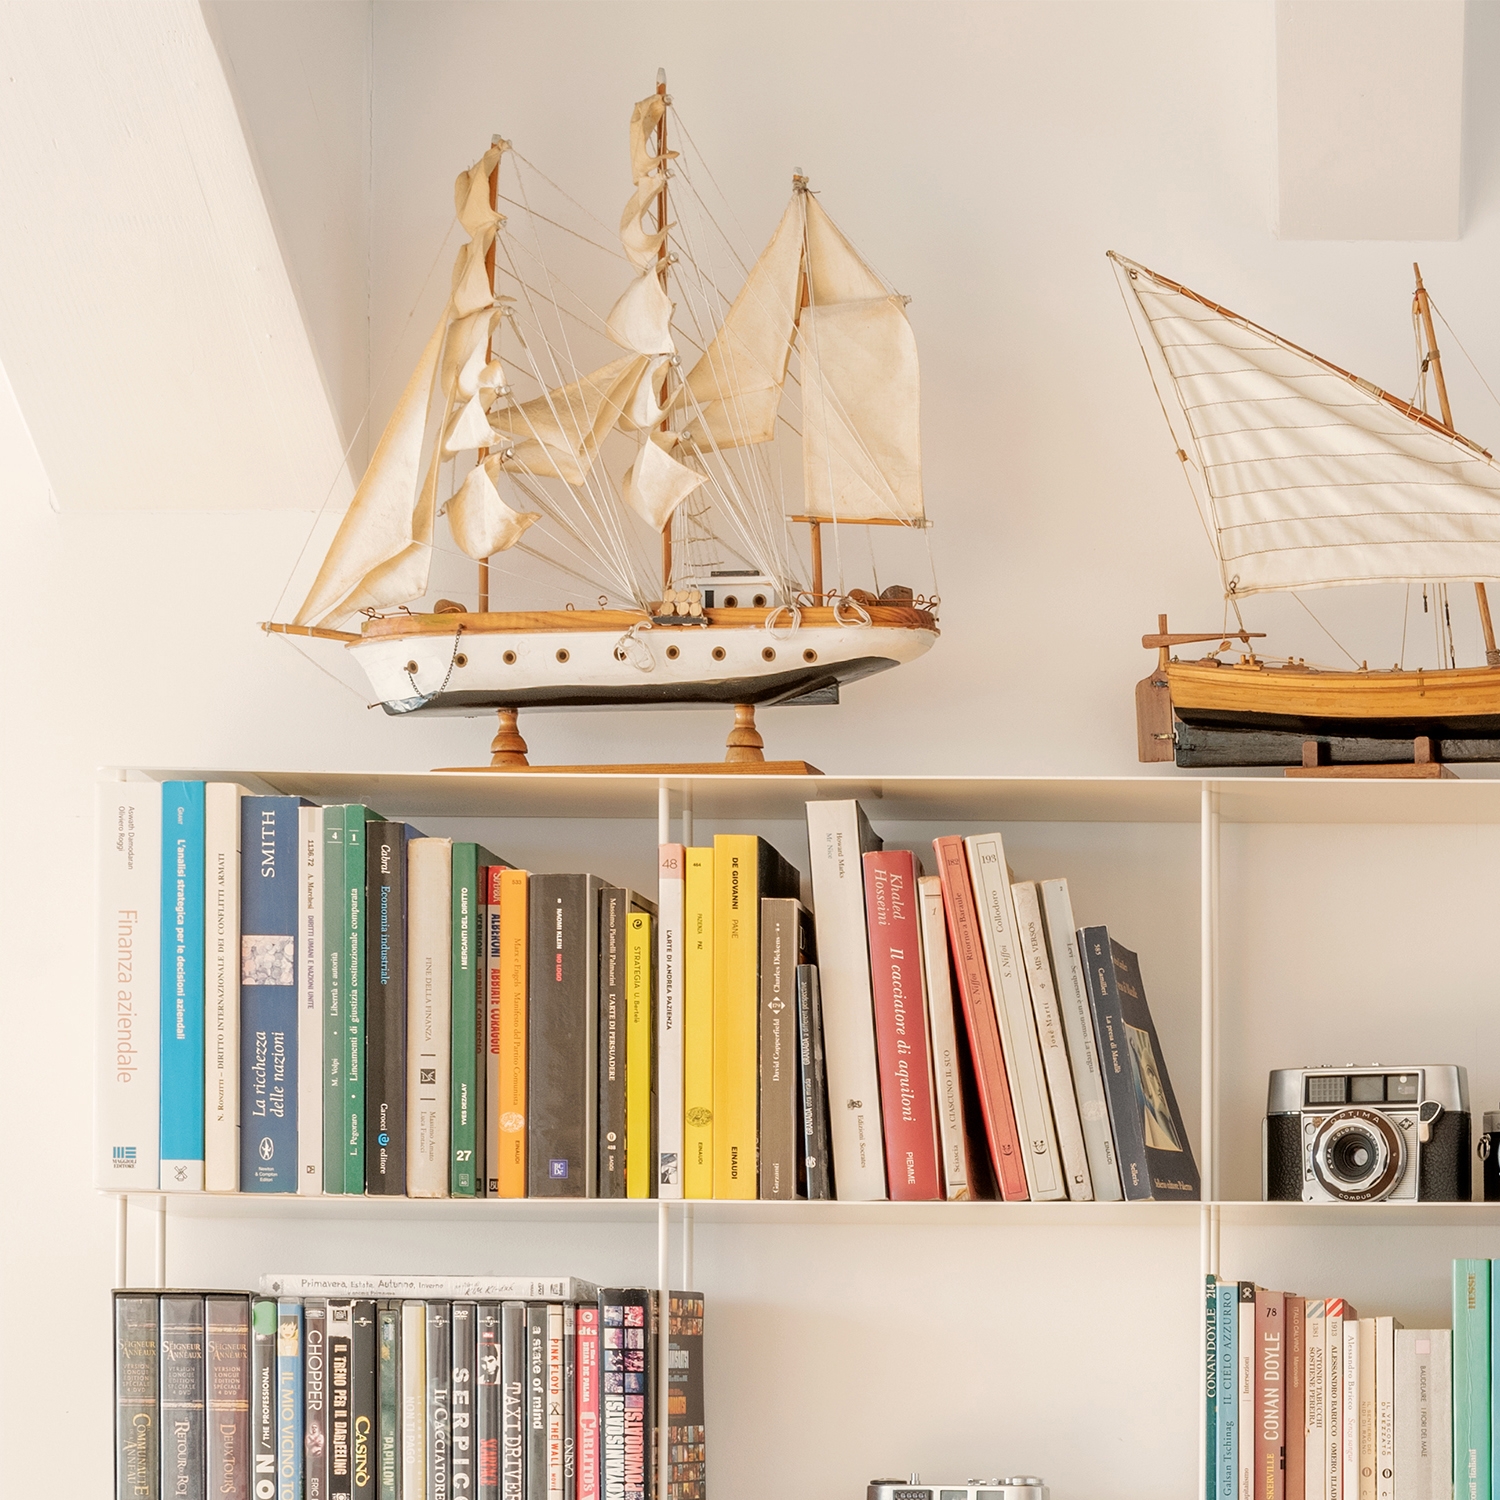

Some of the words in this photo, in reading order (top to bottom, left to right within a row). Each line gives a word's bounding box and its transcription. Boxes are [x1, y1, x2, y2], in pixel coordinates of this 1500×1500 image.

[127, 805, 136, 831] Aswath
[127, 831, 136, 870] Damodaran
[261, 810, 276, 878] SMITH
[380, 844, 391, 874] Cabral
[731, 857, 739, 869] DE
[174, 878, 186, 926] strategica
[381, 886, 391, 932] Economia
[731, 870, 739, 910] GIOVANNI
[874, 869, 889, 926] Hosseini
[890, 873, 905, 920] Khaled
[117, 910, 139, 983] Finanza
[175, 927, 184, 944] per
[176, 944, 186, 954] le
[889, 948, 903, 962] Il
[176, 955, 186, 997] decisioni
[381, 934, 391, 984] industriale
[890, 965, 908, 1035] cacciatore
[1097, 968, 1109, 996] Camilleri
[116, 989, 138, 1084] aziendale
[176, 998, 186, 1040] aziendali
[251, 1031, 268, 1095] ricchezza
[271, 1031, 286, 1082] nazioni
[896, 1040, 911, 1055] di
[252, 1099, 266, 1117] La
[269, 1085, 285, 1118] delle
[895, 1060, 915, 1122] aquiloni
[456, 1149, 472, 1162] 27
[905, 1152, 915, 1184] PIEMME
[1130, 1163, 1140, 1186] Sellerio
[1266, 1307, 1278, 1318] 78
[334, 1344, 347, 1353] IL
[1264, 1332, 1280, 1380] DOYLE
[281, 1371, 294, 1384] IL
[308, 1330, 322, 1410] CHOPPER
[334, 1356, 347, 1386] TRENO
[281, 1389, 294, 1421] MIO
[334, 1390, 347, 1407] PER
[334, 1410, 347, 1418] IL
[434, 1388, 447, 1404] IL
[504, 1381, 522, 1432] TAXI
[1263, 1388, 1279, 1440] CONAN
[281, 1424, 294, 1478] VICINO
[355, 1416, 371, 1487] CASINÒ
[434, 1408, 448, 1500] CACCIATORE
[311, 1478, 319, 1497] ERIC
